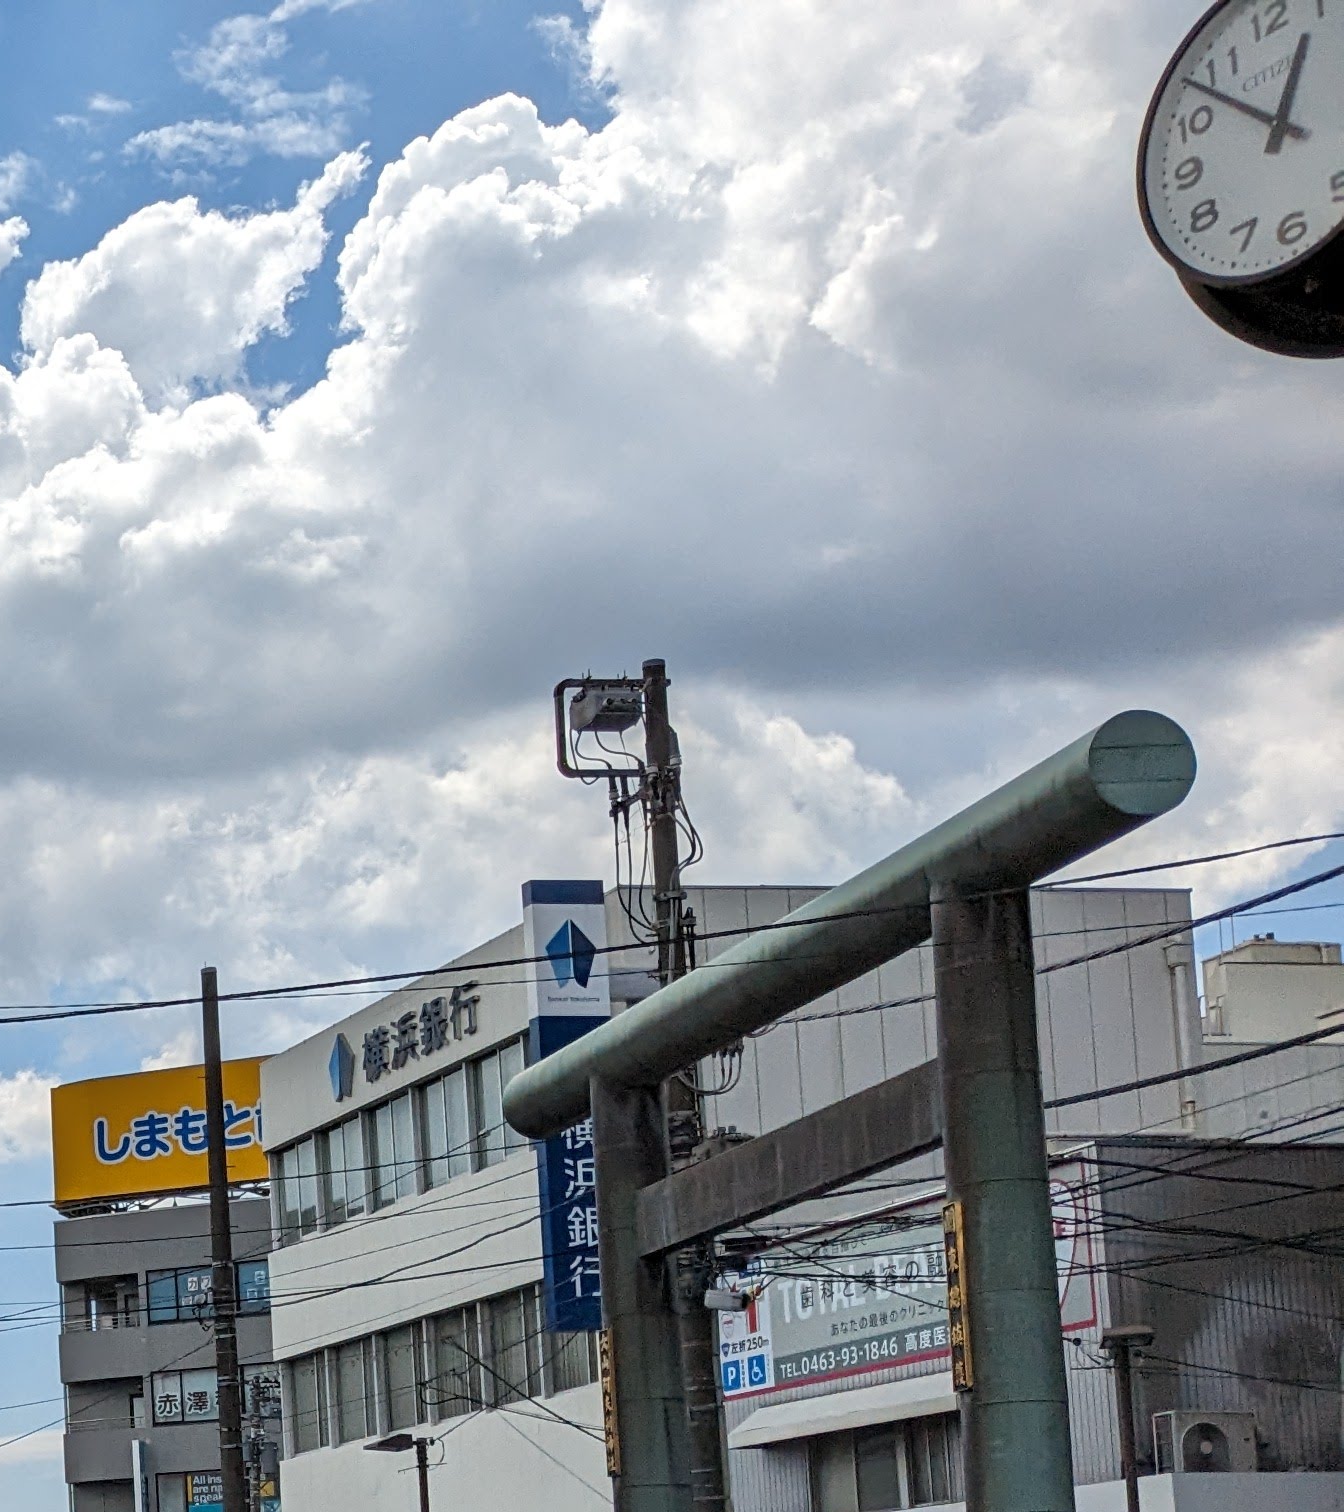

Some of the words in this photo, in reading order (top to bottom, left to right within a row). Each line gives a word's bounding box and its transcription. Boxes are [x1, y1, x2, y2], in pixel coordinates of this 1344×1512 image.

[1251, 0, 1289, 42] 12
[1206, 46, 1238, 87] 11
[1243, 54, 1292, 92] CITIZ
[1178, 105, 1213, 144] 10
[1174, 156, 1203, 190] 9
[1190, 199, 1219, 233] 8
[1277, 211, 1307, 245] 6
[1229, 217, 1258, 253] 7
[362, 980, 481, 1084] 横浜銀行
[94, 1101, 262, 1164] しまもと
[904, 1325, 950, 1354] 高度医
[157, 1392, 220, 1416] 赤澤
[193, 1475, 206, 1484] All
[207, 1474, 222, 1484] ins
